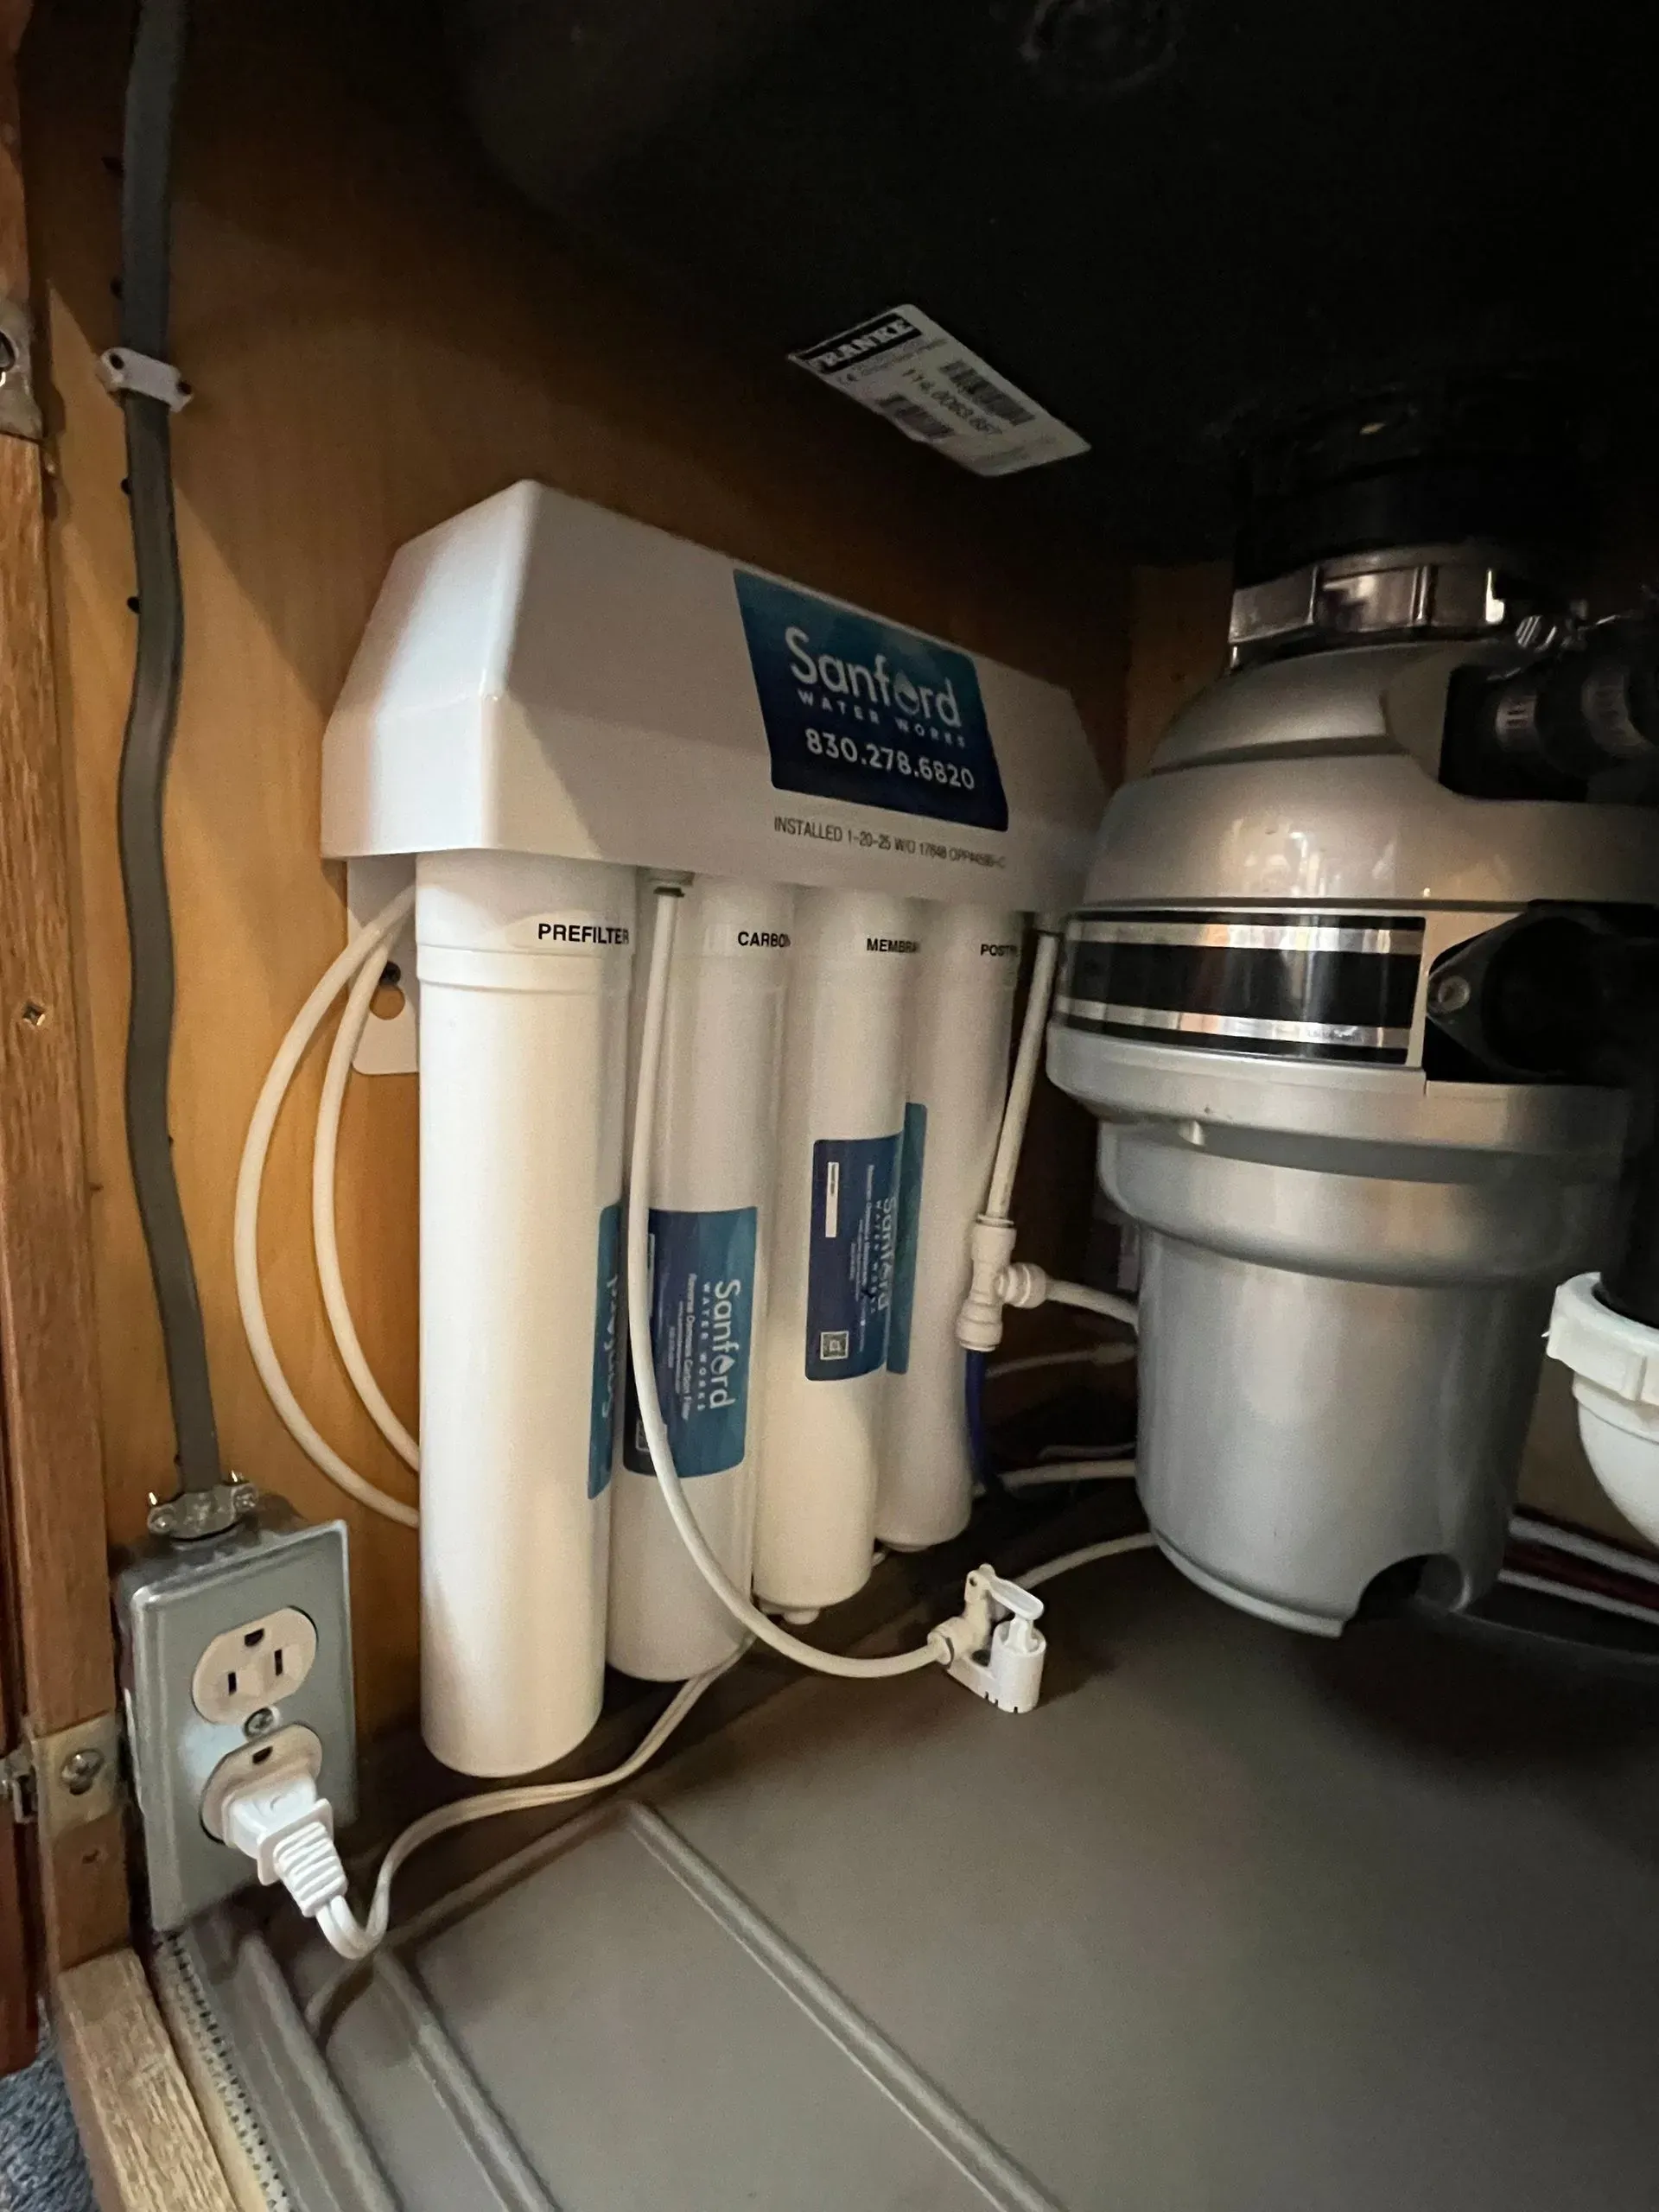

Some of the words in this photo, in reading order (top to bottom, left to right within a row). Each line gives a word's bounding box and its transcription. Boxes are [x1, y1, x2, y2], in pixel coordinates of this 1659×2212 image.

[784, 626, 963, 728] Sanford
[797, 688, 881, 726] WATER
[896, 716, 967, 749] WORKS
[804, 727, 976, 791] 830.278.6820
[773, 815, 843, 843] INSTALLED
[537, 922, 630, 947] PREFILTER
[700, 1282, 710, 1340] WATER
[709, 1278, 742, 1410] Sanford
[696, 1353, 708, 1411] WORKS
